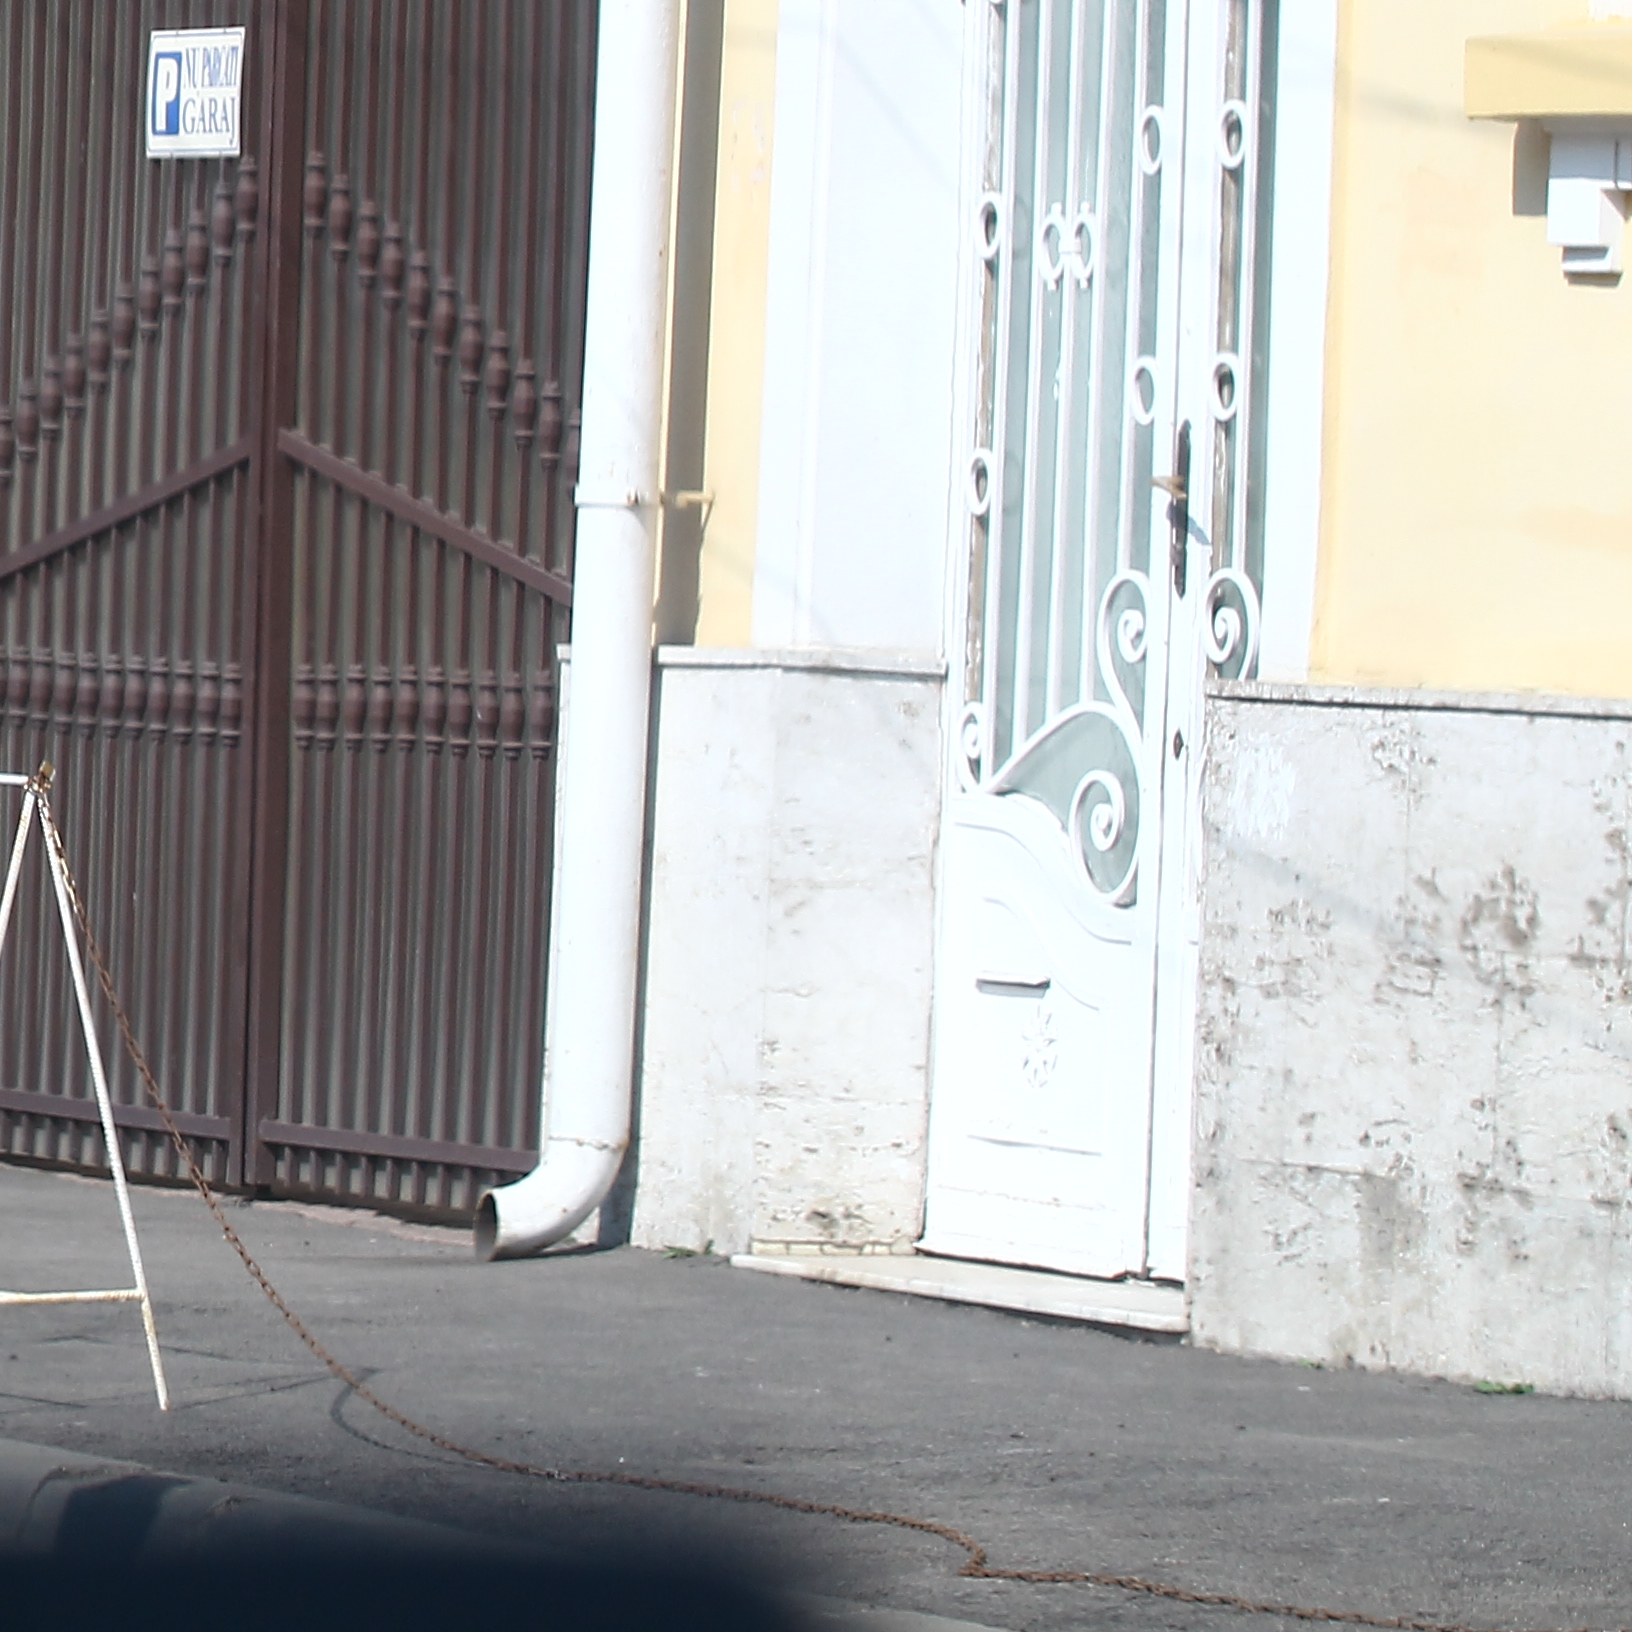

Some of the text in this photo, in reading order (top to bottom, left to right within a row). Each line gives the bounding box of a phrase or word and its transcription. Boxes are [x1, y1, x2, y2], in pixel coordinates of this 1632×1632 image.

[183, 47, 200, 89] NU
[155, 57, 178, 132] P
[182, 97, 236, 146] GARAJ
